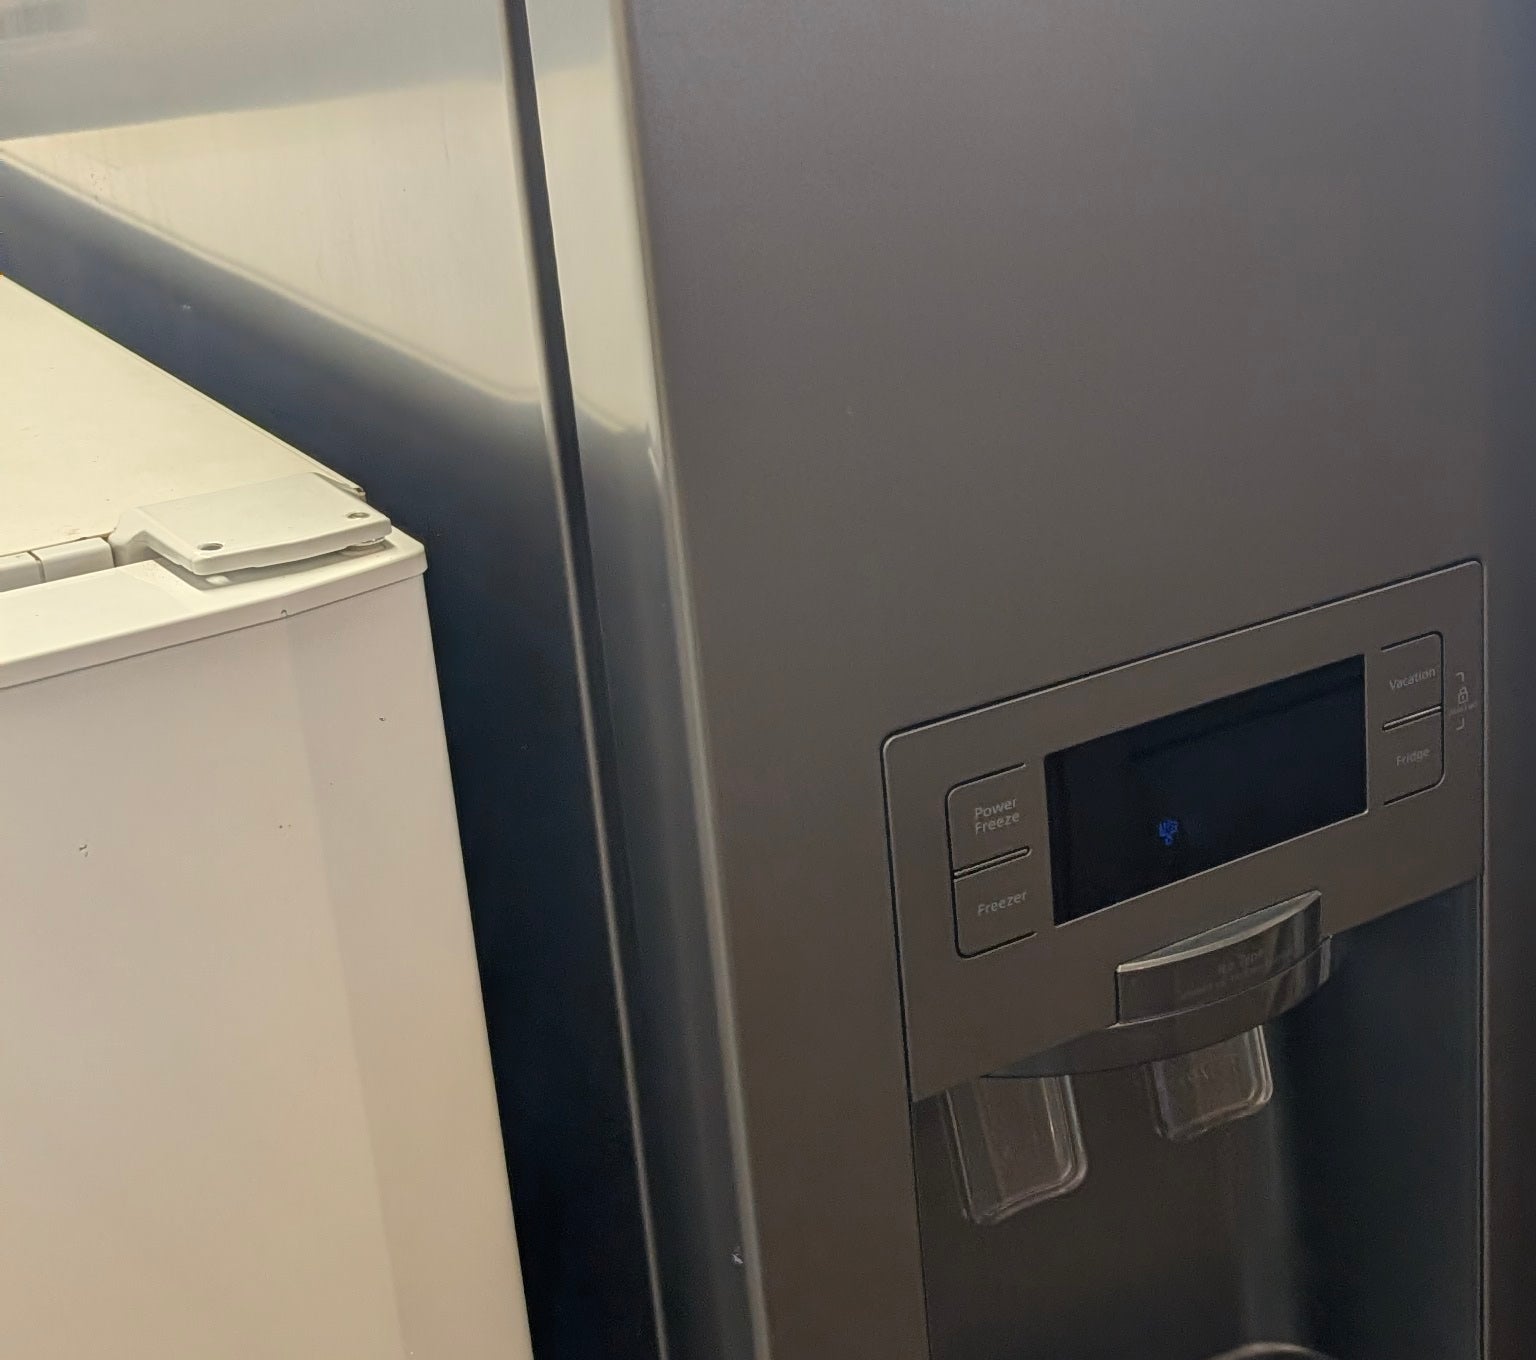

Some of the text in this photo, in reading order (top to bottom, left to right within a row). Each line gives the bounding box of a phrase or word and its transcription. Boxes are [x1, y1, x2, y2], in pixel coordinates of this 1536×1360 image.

[1389, 667, 1437, 691] Vacation
[1396, 747, 1432, 767] Fridge
[974, 798, 1018, 821] Power
[974, 811, 1021, 836] Freeze
[976, 890, 1028, 917] Freezer
